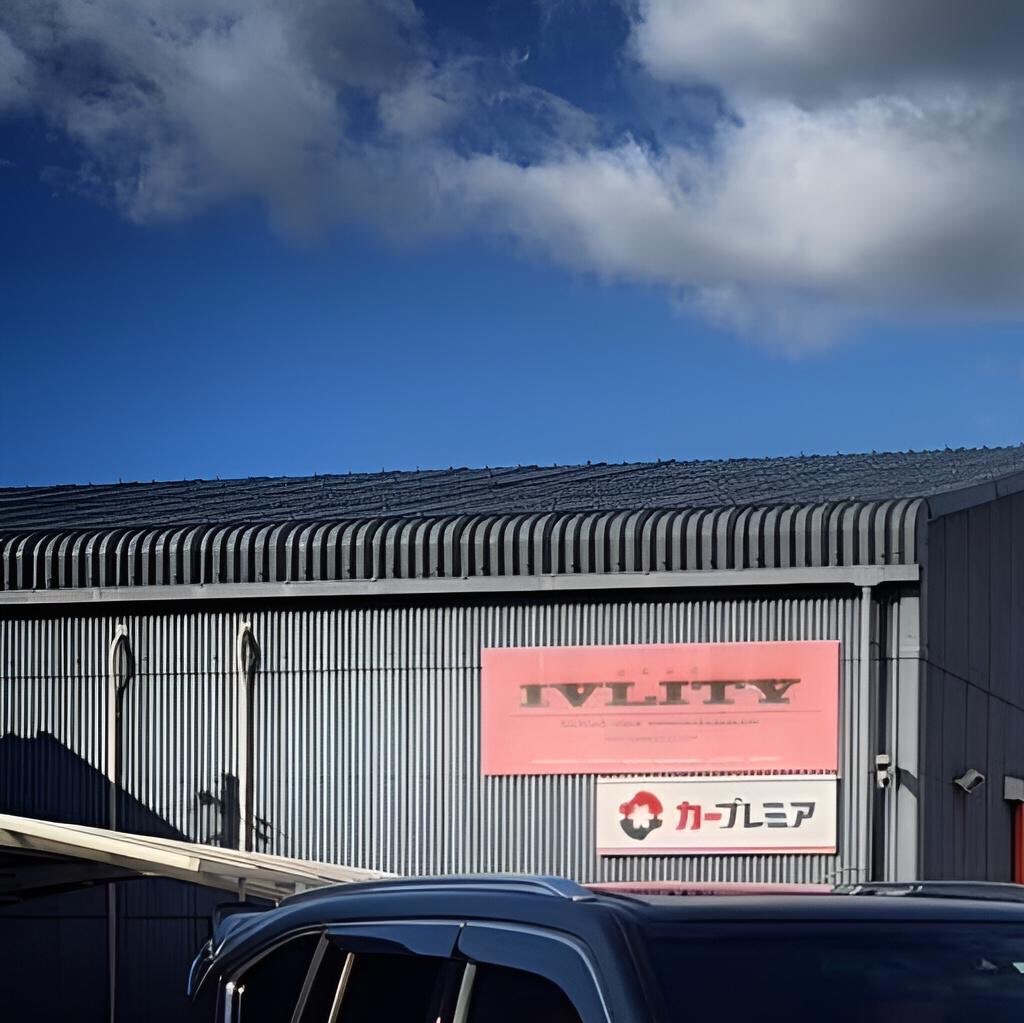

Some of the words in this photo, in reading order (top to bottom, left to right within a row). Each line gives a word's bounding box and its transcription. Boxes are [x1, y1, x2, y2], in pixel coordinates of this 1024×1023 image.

[519, 678, 801, 708] IVLITY
[675, 797, 816, 831] カープレミア
